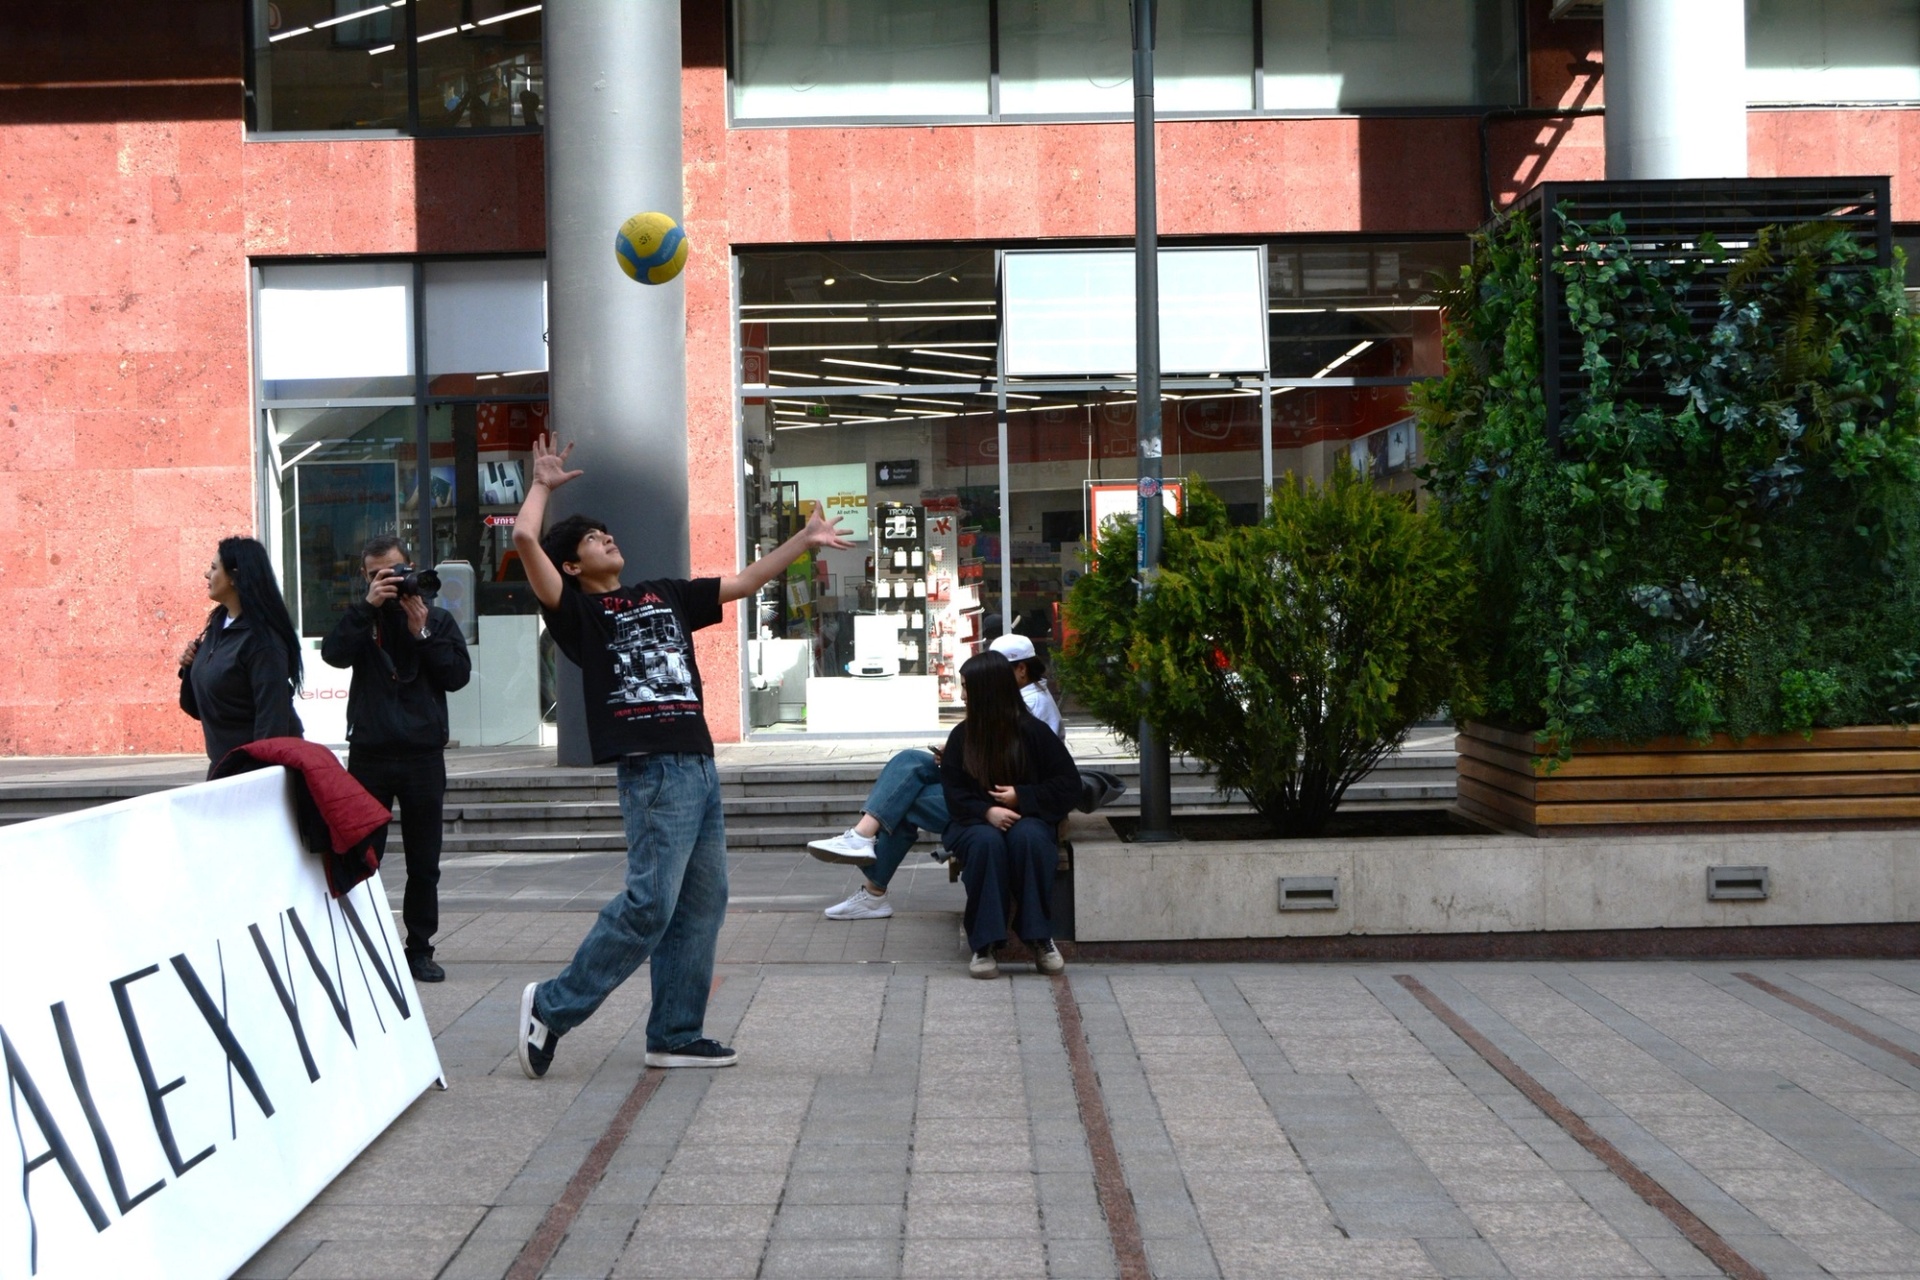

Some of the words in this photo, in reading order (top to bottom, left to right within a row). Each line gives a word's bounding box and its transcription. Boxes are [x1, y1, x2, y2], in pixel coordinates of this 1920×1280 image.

[826, 495, 868, 509] PRO
[887, 508, 915, 516] TROIKA
[301, 687, 349, 700] eldo
